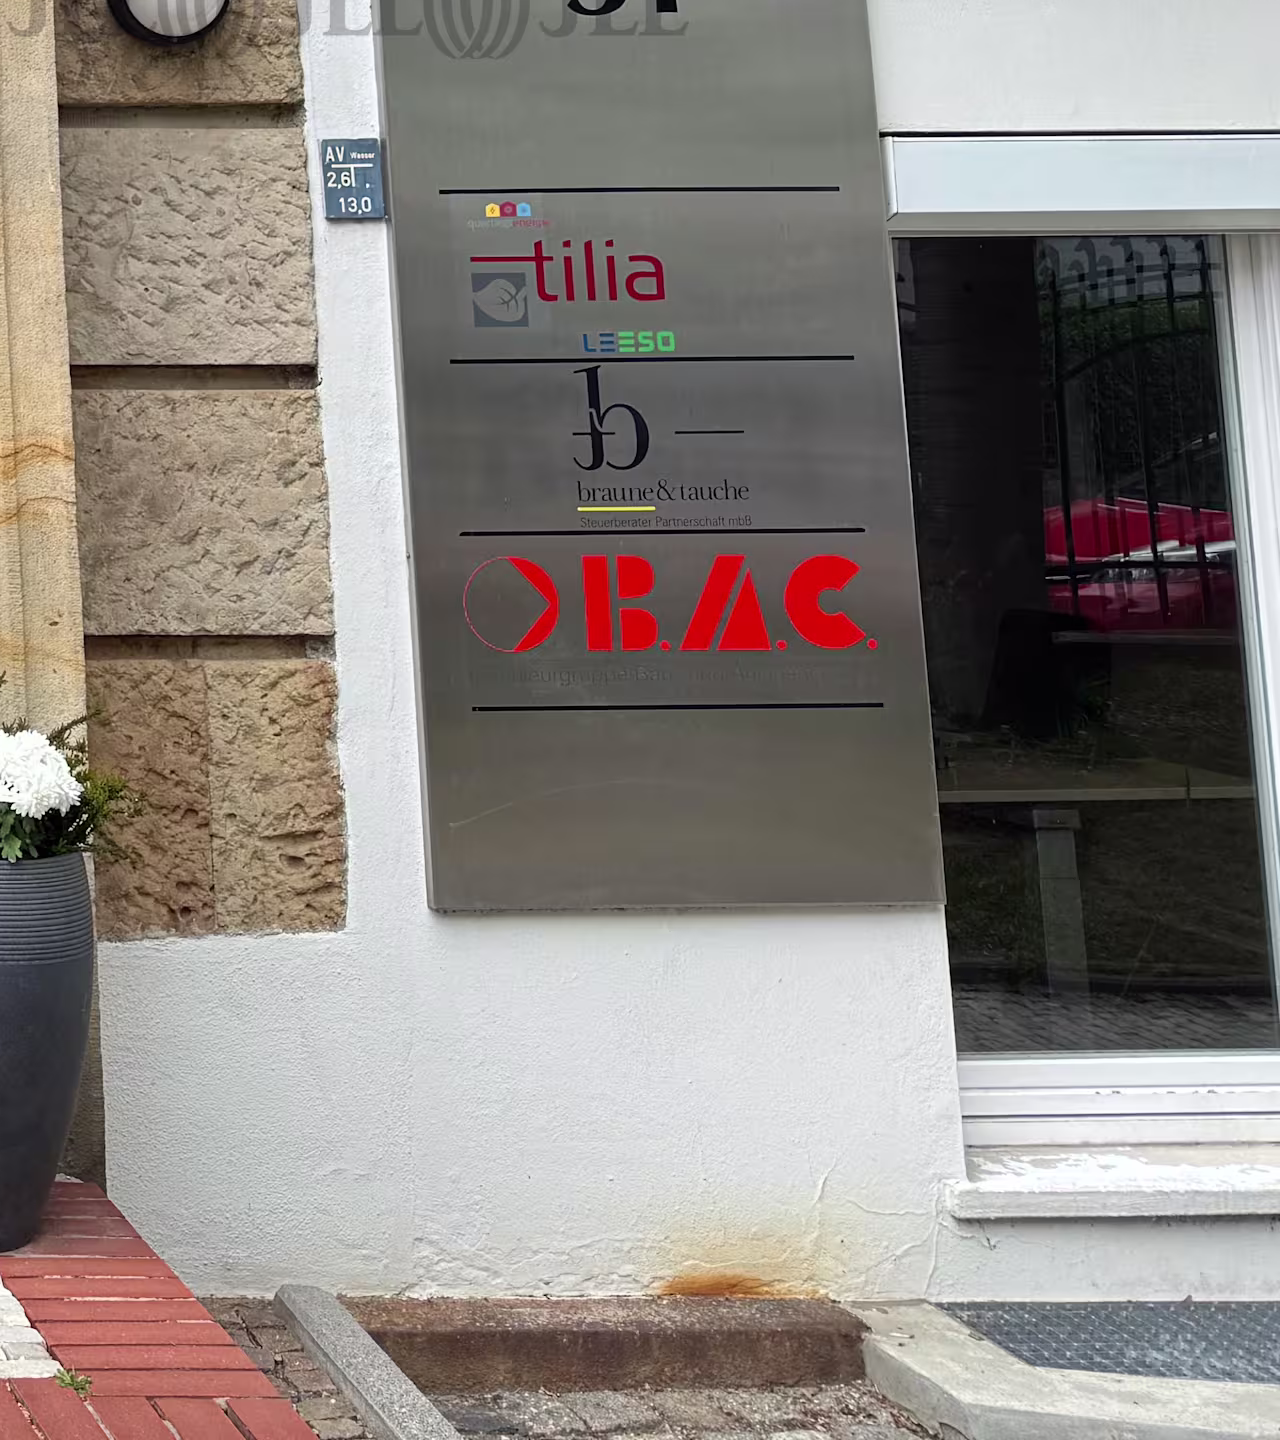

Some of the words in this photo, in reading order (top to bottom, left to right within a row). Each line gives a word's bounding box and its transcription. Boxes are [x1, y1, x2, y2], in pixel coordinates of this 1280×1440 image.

[325, 146, 344, 162] AV
[327, 172, 351, 189] 2,6
[339, 196, 372, 214] 13,0
[471, 240, 666, 302] tilia
[582, 331, 676, 353] LEESO
[580, 517, 652, 529] Steuerberater
[655, 515, 726, 528] Partnerschaft
[728, 515, 753, 527] mbB
